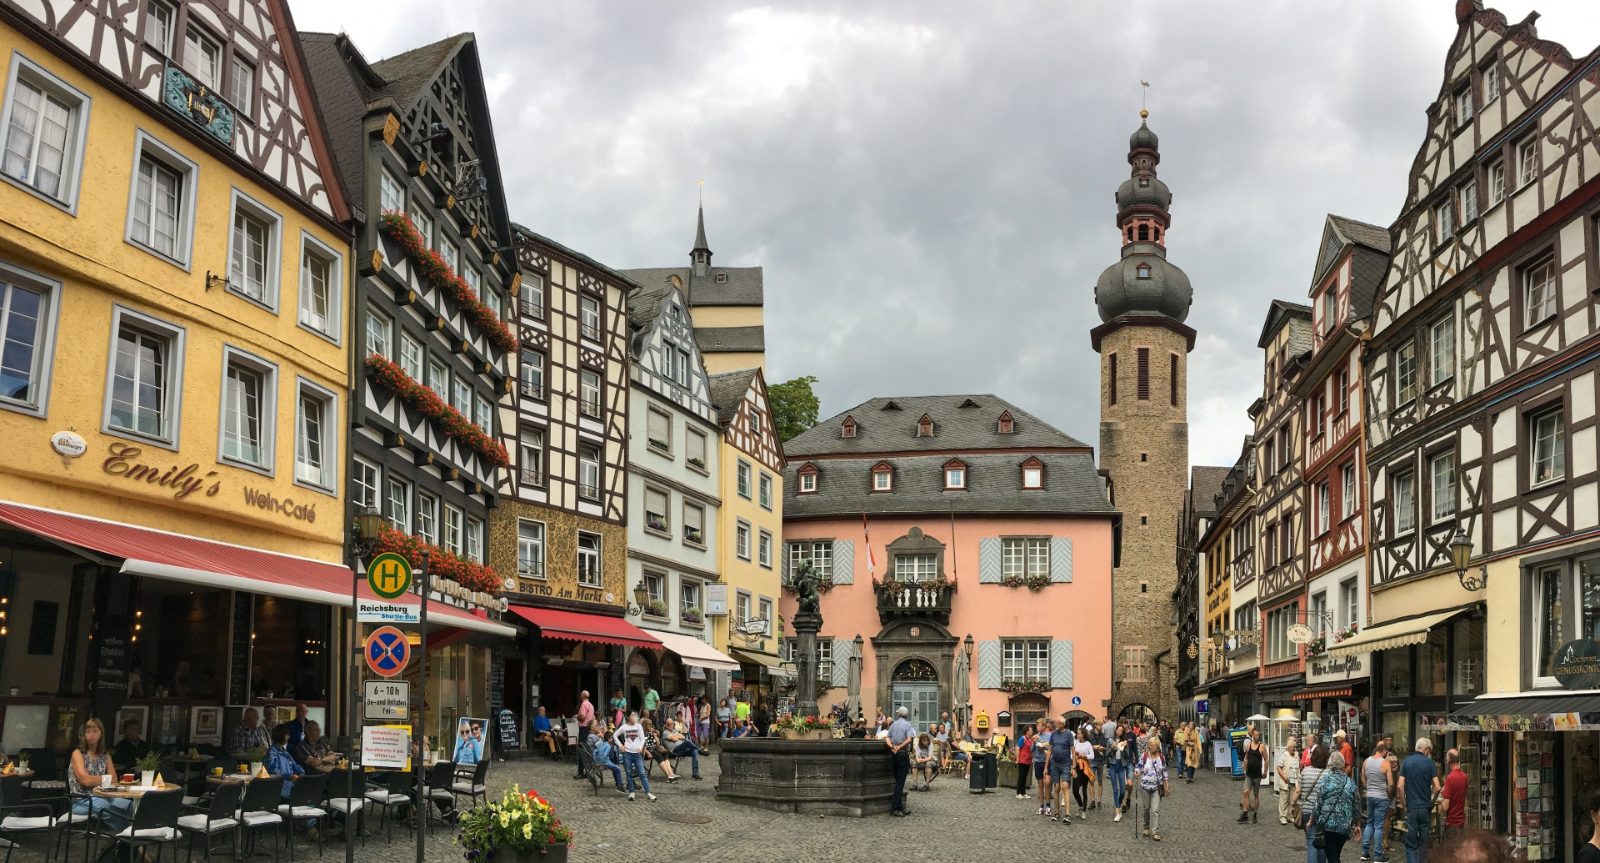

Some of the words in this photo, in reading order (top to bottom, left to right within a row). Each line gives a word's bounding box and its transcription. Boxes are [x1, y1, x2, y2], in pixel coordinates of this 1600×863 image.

[243, 485, 317, 523] Wein-Café
[381, 563, 398, 589] H
[519, 582, 553, 596] BISTRO
[556, 586, 573, 599] Am
[575, 587, 603, 602] Markt
[360, 604, 408, 615] Reichsburg
[373, 686, 379, 695] 6
